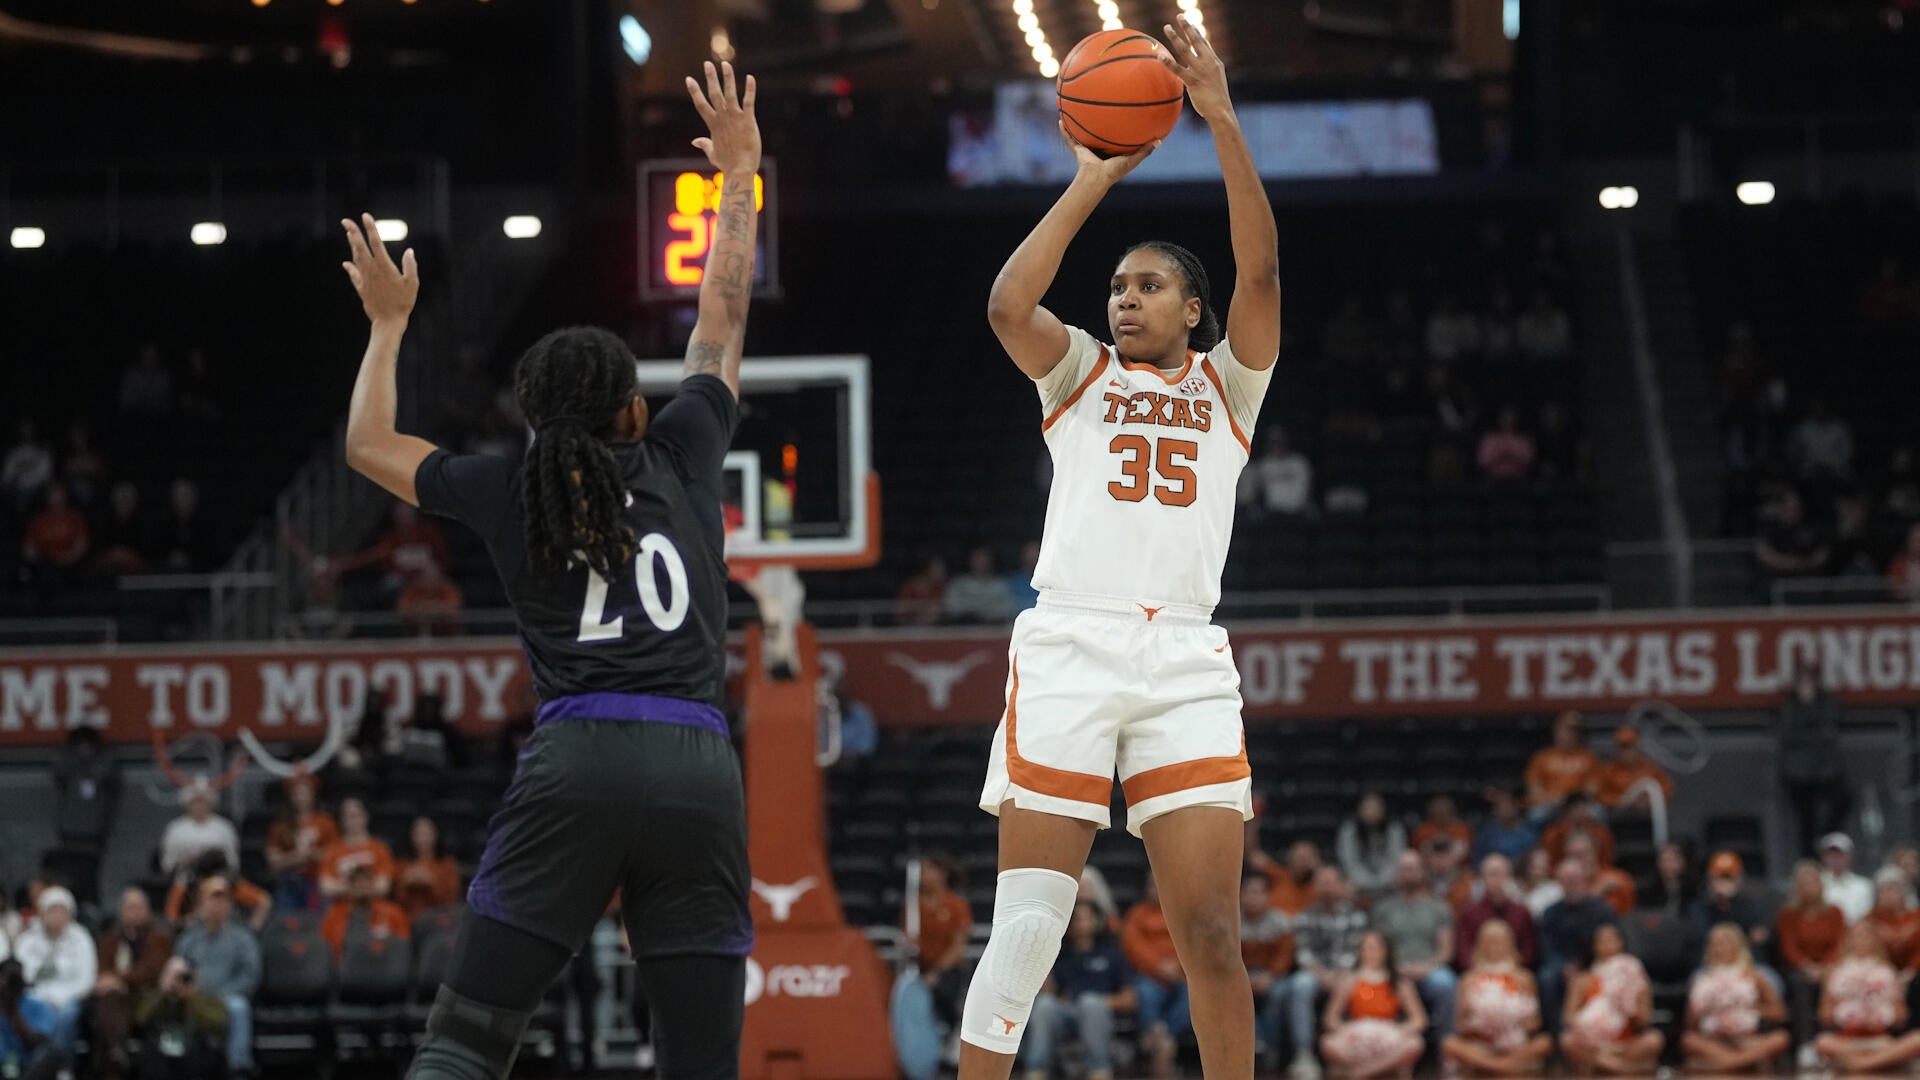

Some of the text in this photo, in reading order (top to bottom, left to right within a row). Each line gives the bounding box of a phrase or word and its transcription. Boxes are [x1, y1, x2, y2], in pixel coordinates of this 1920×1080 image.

[665, 213, 718, 286] 2
[1103, 391, 1212, 433] TEXAS
[1180, 378, 1206, 395] SEC
[1108, 434, 1198, 507] 35
[1241, 624, 1920, 703] OF THE TEXAS LONG
[1, 666, 109, 731] ME
[137, 664, 231, 728] TO
[767, 965, 850, 997] razr
